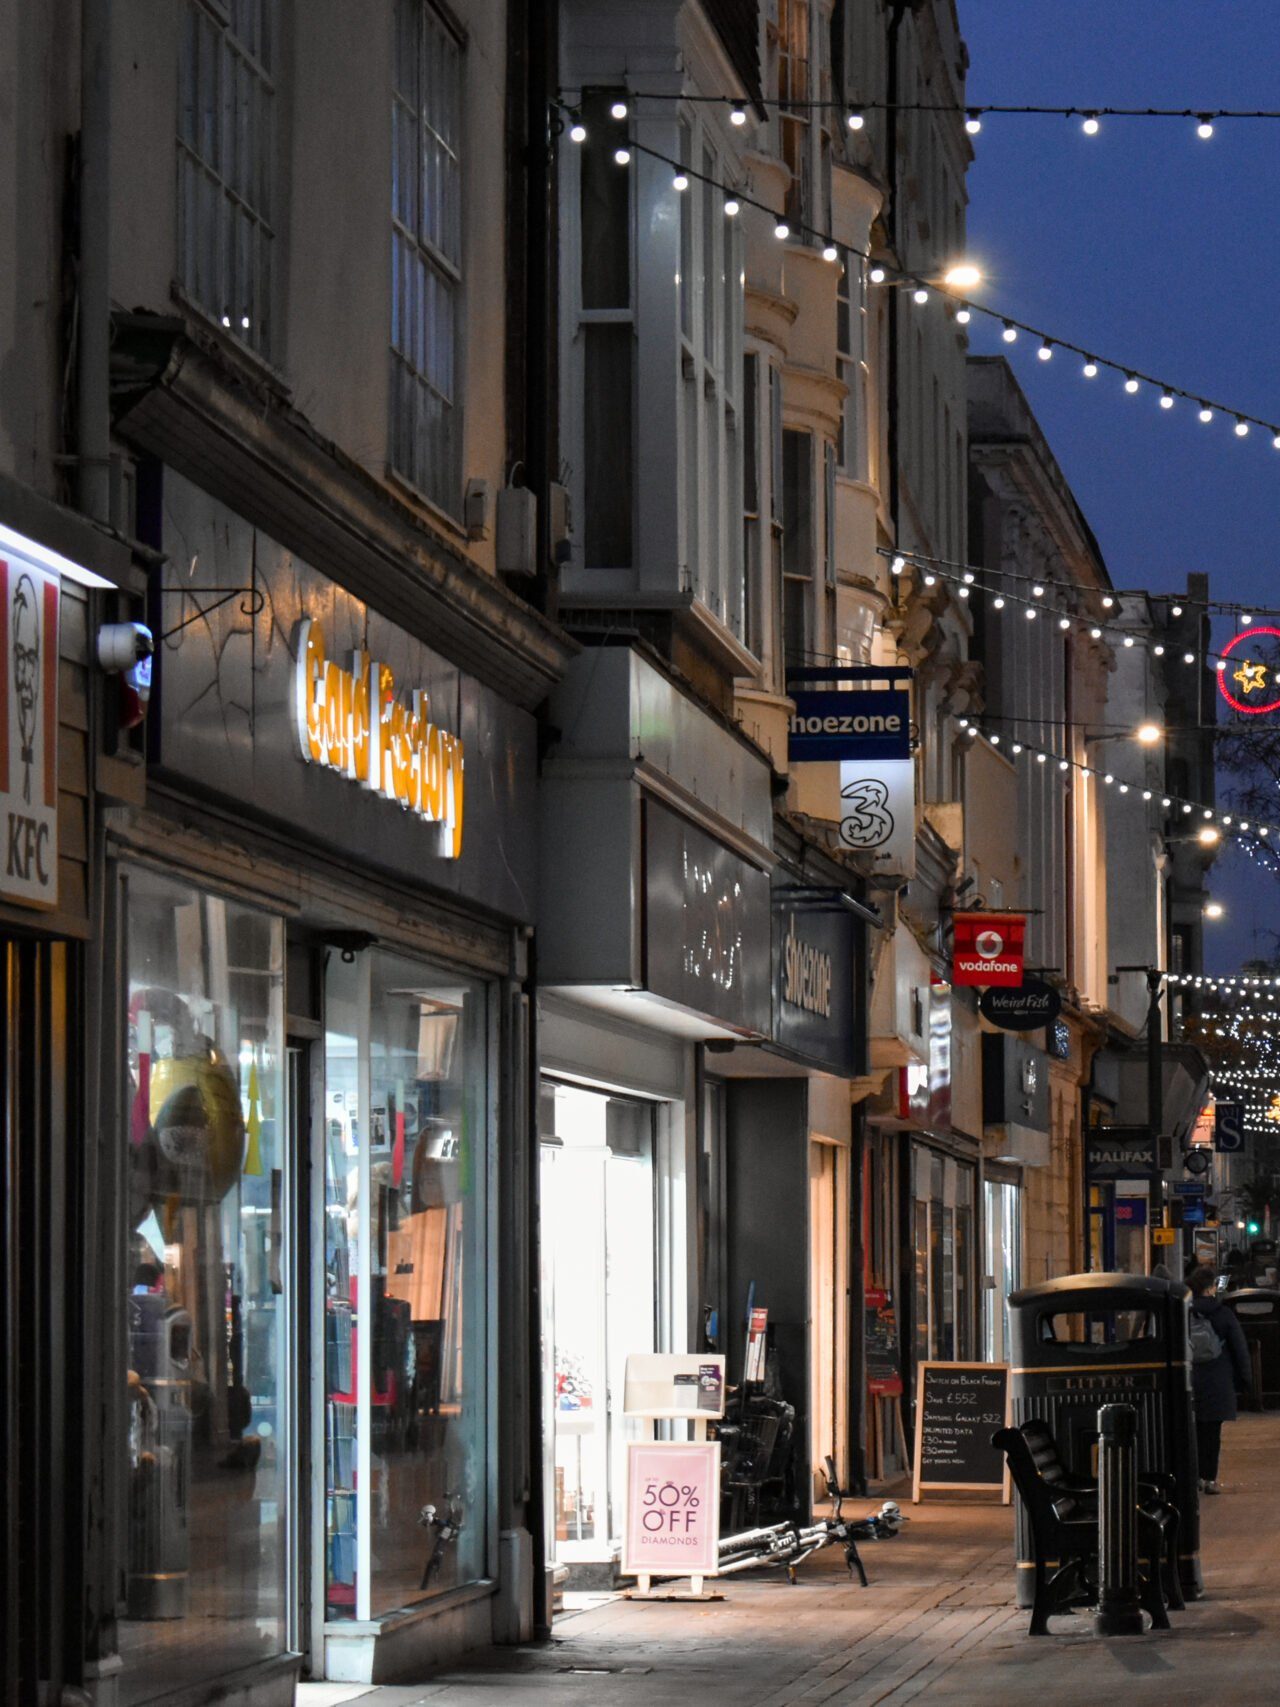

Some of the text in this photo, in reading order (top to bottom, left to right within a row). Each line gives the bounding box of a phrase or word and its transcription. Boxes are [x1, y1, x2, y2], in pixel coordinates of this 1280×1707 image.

[787, 713, 901, 734] hoezone
[7, 812, 48, 886] KFC
[785, 912, 832, 1018] shoezone
[959, 960, 1018, 973] vodafone
[992, 994, 1049, 1008] Weird Fish
[1089, 1151, 1153, 1163] HALIFAX
[1066, 1375, 1135, 1390] LITTER
[947, 1393, 978, 1404] £552
[982, 1413, 1002, 1424] S22
[954, 1428, 973, 1436] DATA
[643, 1482, 700, 1507] 50%
[643, 1509, 697, 1532] OFF
[641, 1536, 698, 1546] DIAMONDS
